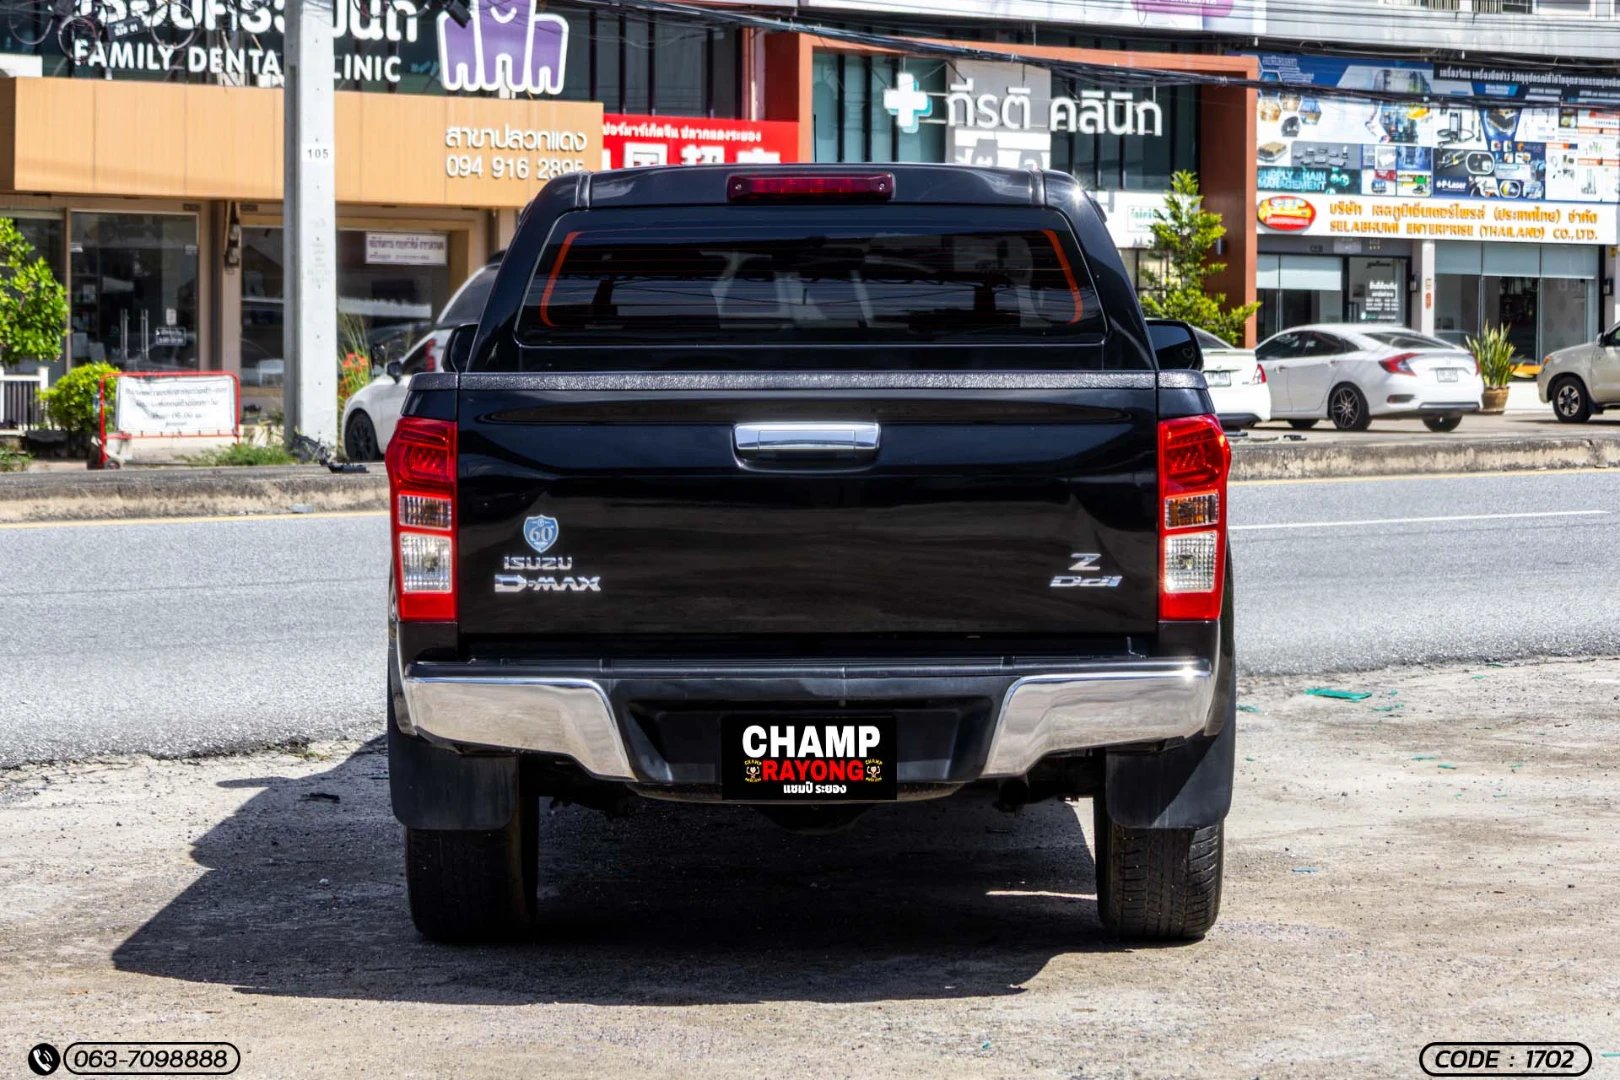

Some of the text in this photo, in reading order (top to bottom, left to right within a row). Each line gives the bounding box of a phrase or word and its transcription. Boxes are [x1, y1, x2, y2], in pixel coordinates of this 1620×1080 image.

[74, 39, 175, 71] FAMILY
[188, 47, 281, 75] DENTA
[946, 78, 1163, 136] กีรติ คลินิก
[445, 123, 588, 152] สาขาปลวกแดง
[307, 148, 329, 159] 105
[446, 154, 483, 177] 094
[491, 157, 529, 179] 916
[1258, 179, 1326, 191] MANAGEMENT
[1330, 200, 1363, 216] บริษัท
[1567, 209, 1598, 224] จำกัด
[1330, 219, 1400, 234] SELABHUMI
[1406, 223, 1474, 237] ENTERPRISE
[1479, 225, 1545, 240] (THAILAND)
[504, 556, 573, 570] ISUZU
[1068, 552, 1102, 571] Z
[494, 574, 601, 593] D-MAX
